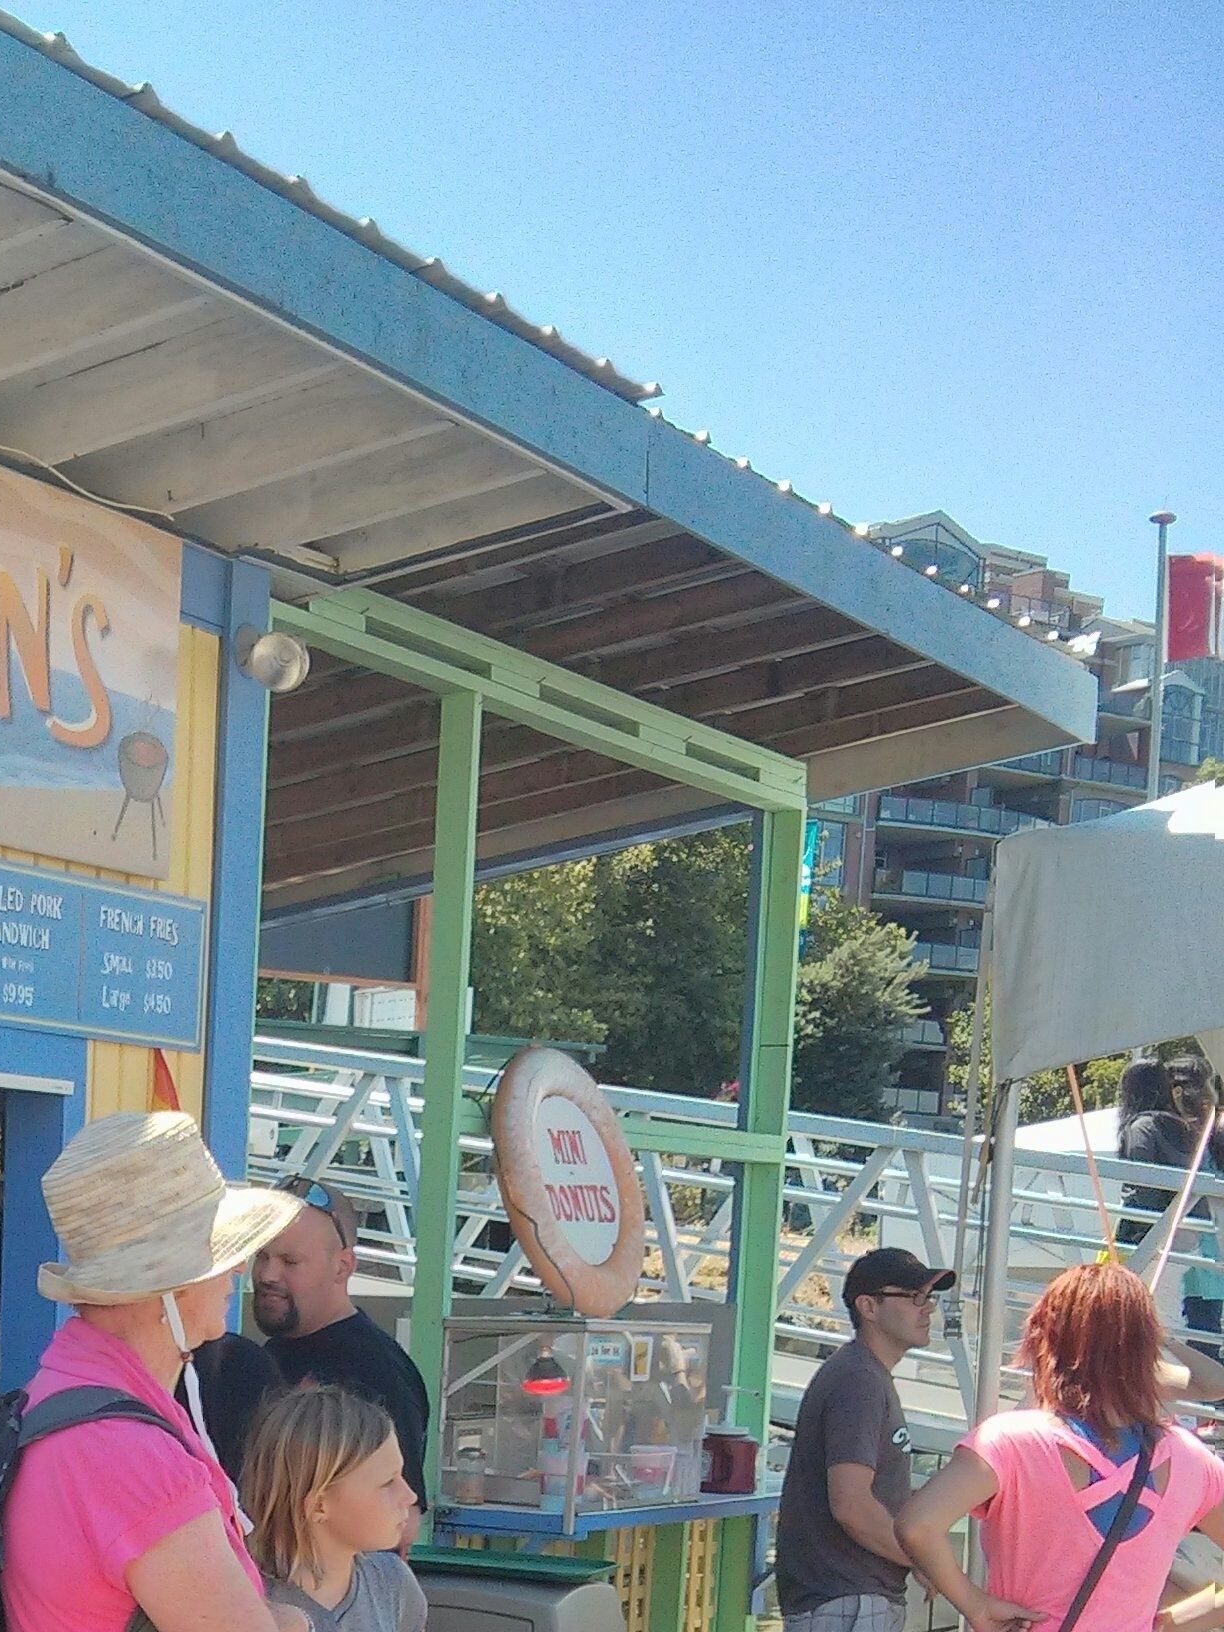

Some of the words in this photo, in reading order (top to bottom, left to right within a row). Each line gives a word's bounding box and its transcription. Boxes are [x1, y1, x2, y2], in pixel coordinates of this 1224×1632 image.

[30, 893, 63, 920] PORK
[99, 906, 144, 936] FRENCH
[149, 915, 180, 946] FRIES
[547, 1128, 588, 1165] MINI
[543, 1184, 616, 1224] DONUTS
